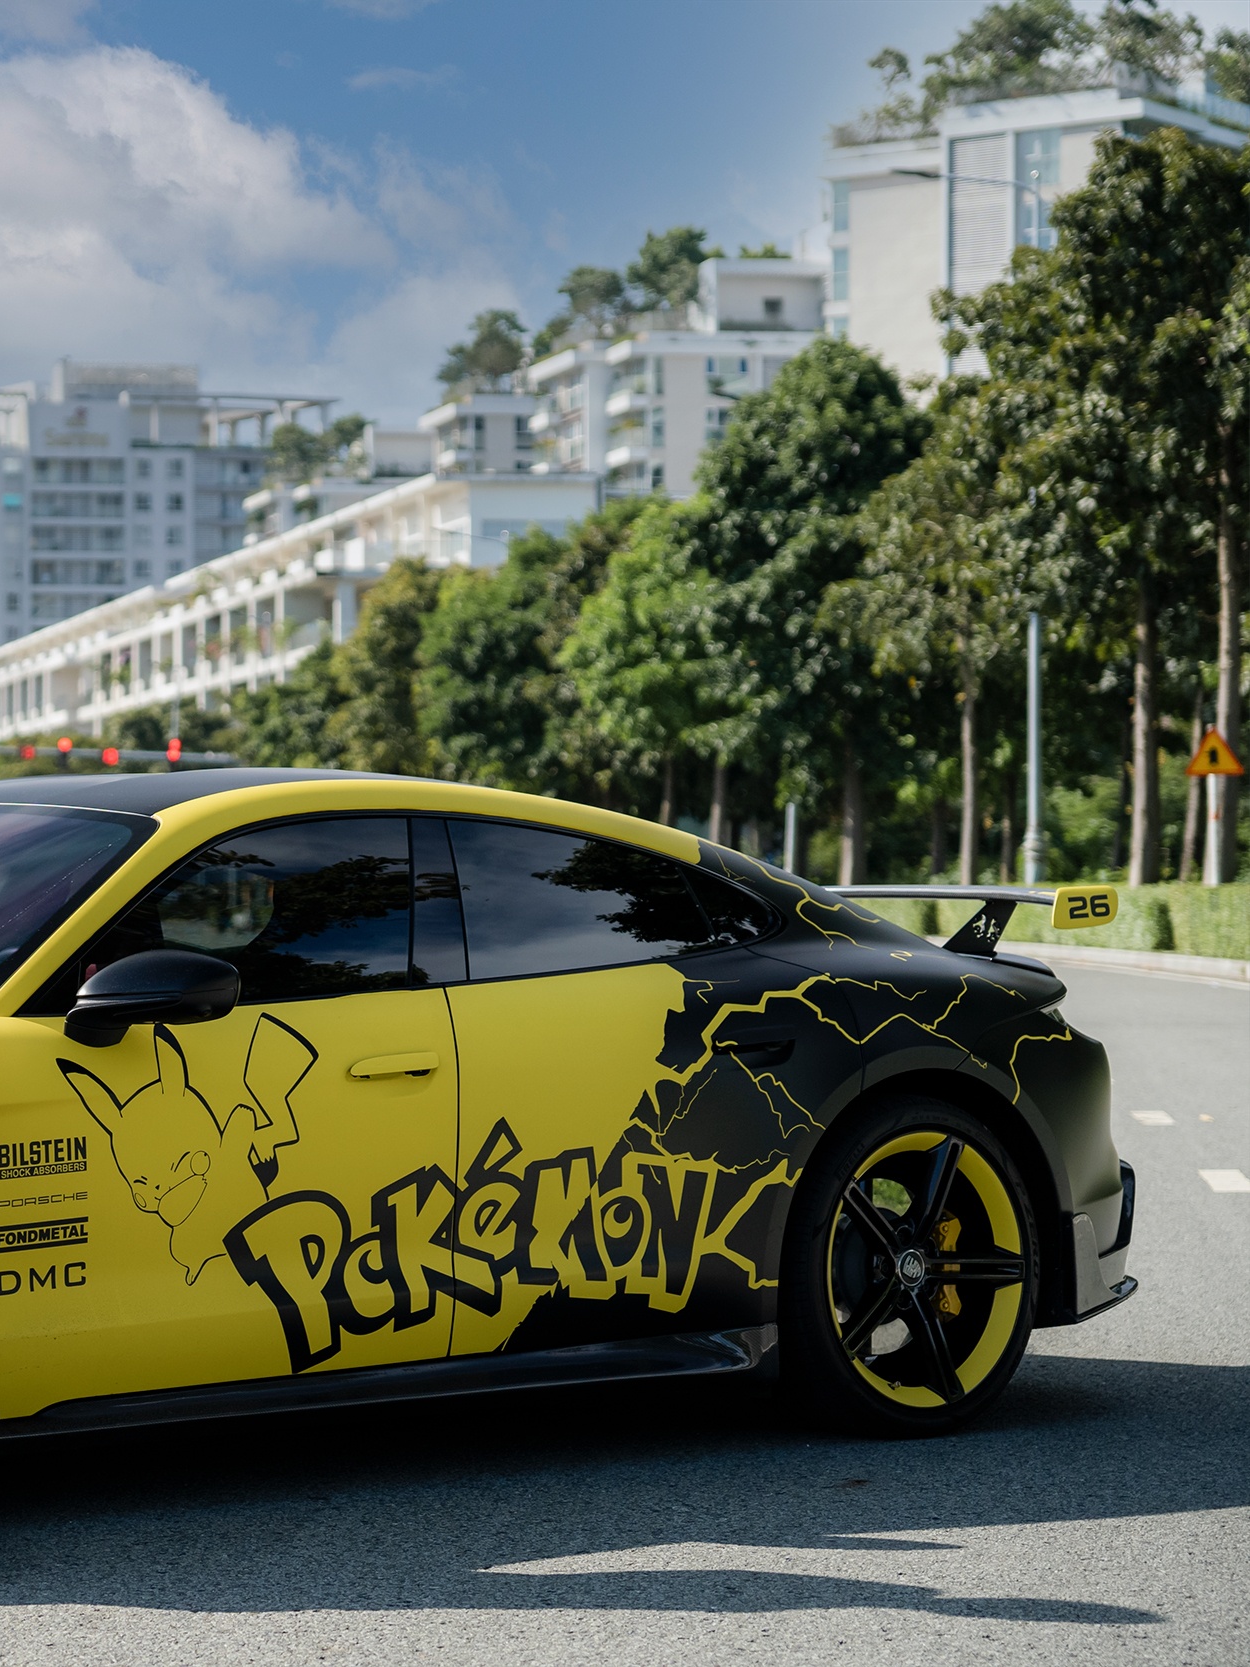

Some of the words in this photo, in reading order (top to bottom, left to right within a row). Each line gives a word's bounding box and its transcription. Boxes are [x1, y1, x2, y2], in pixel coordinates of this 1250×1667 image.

[1067, 894, 1110, 919] 26
[0, 1168, 31, 1179] SHOCK
[33, 1162, 86, 1176] ABSORBERS
